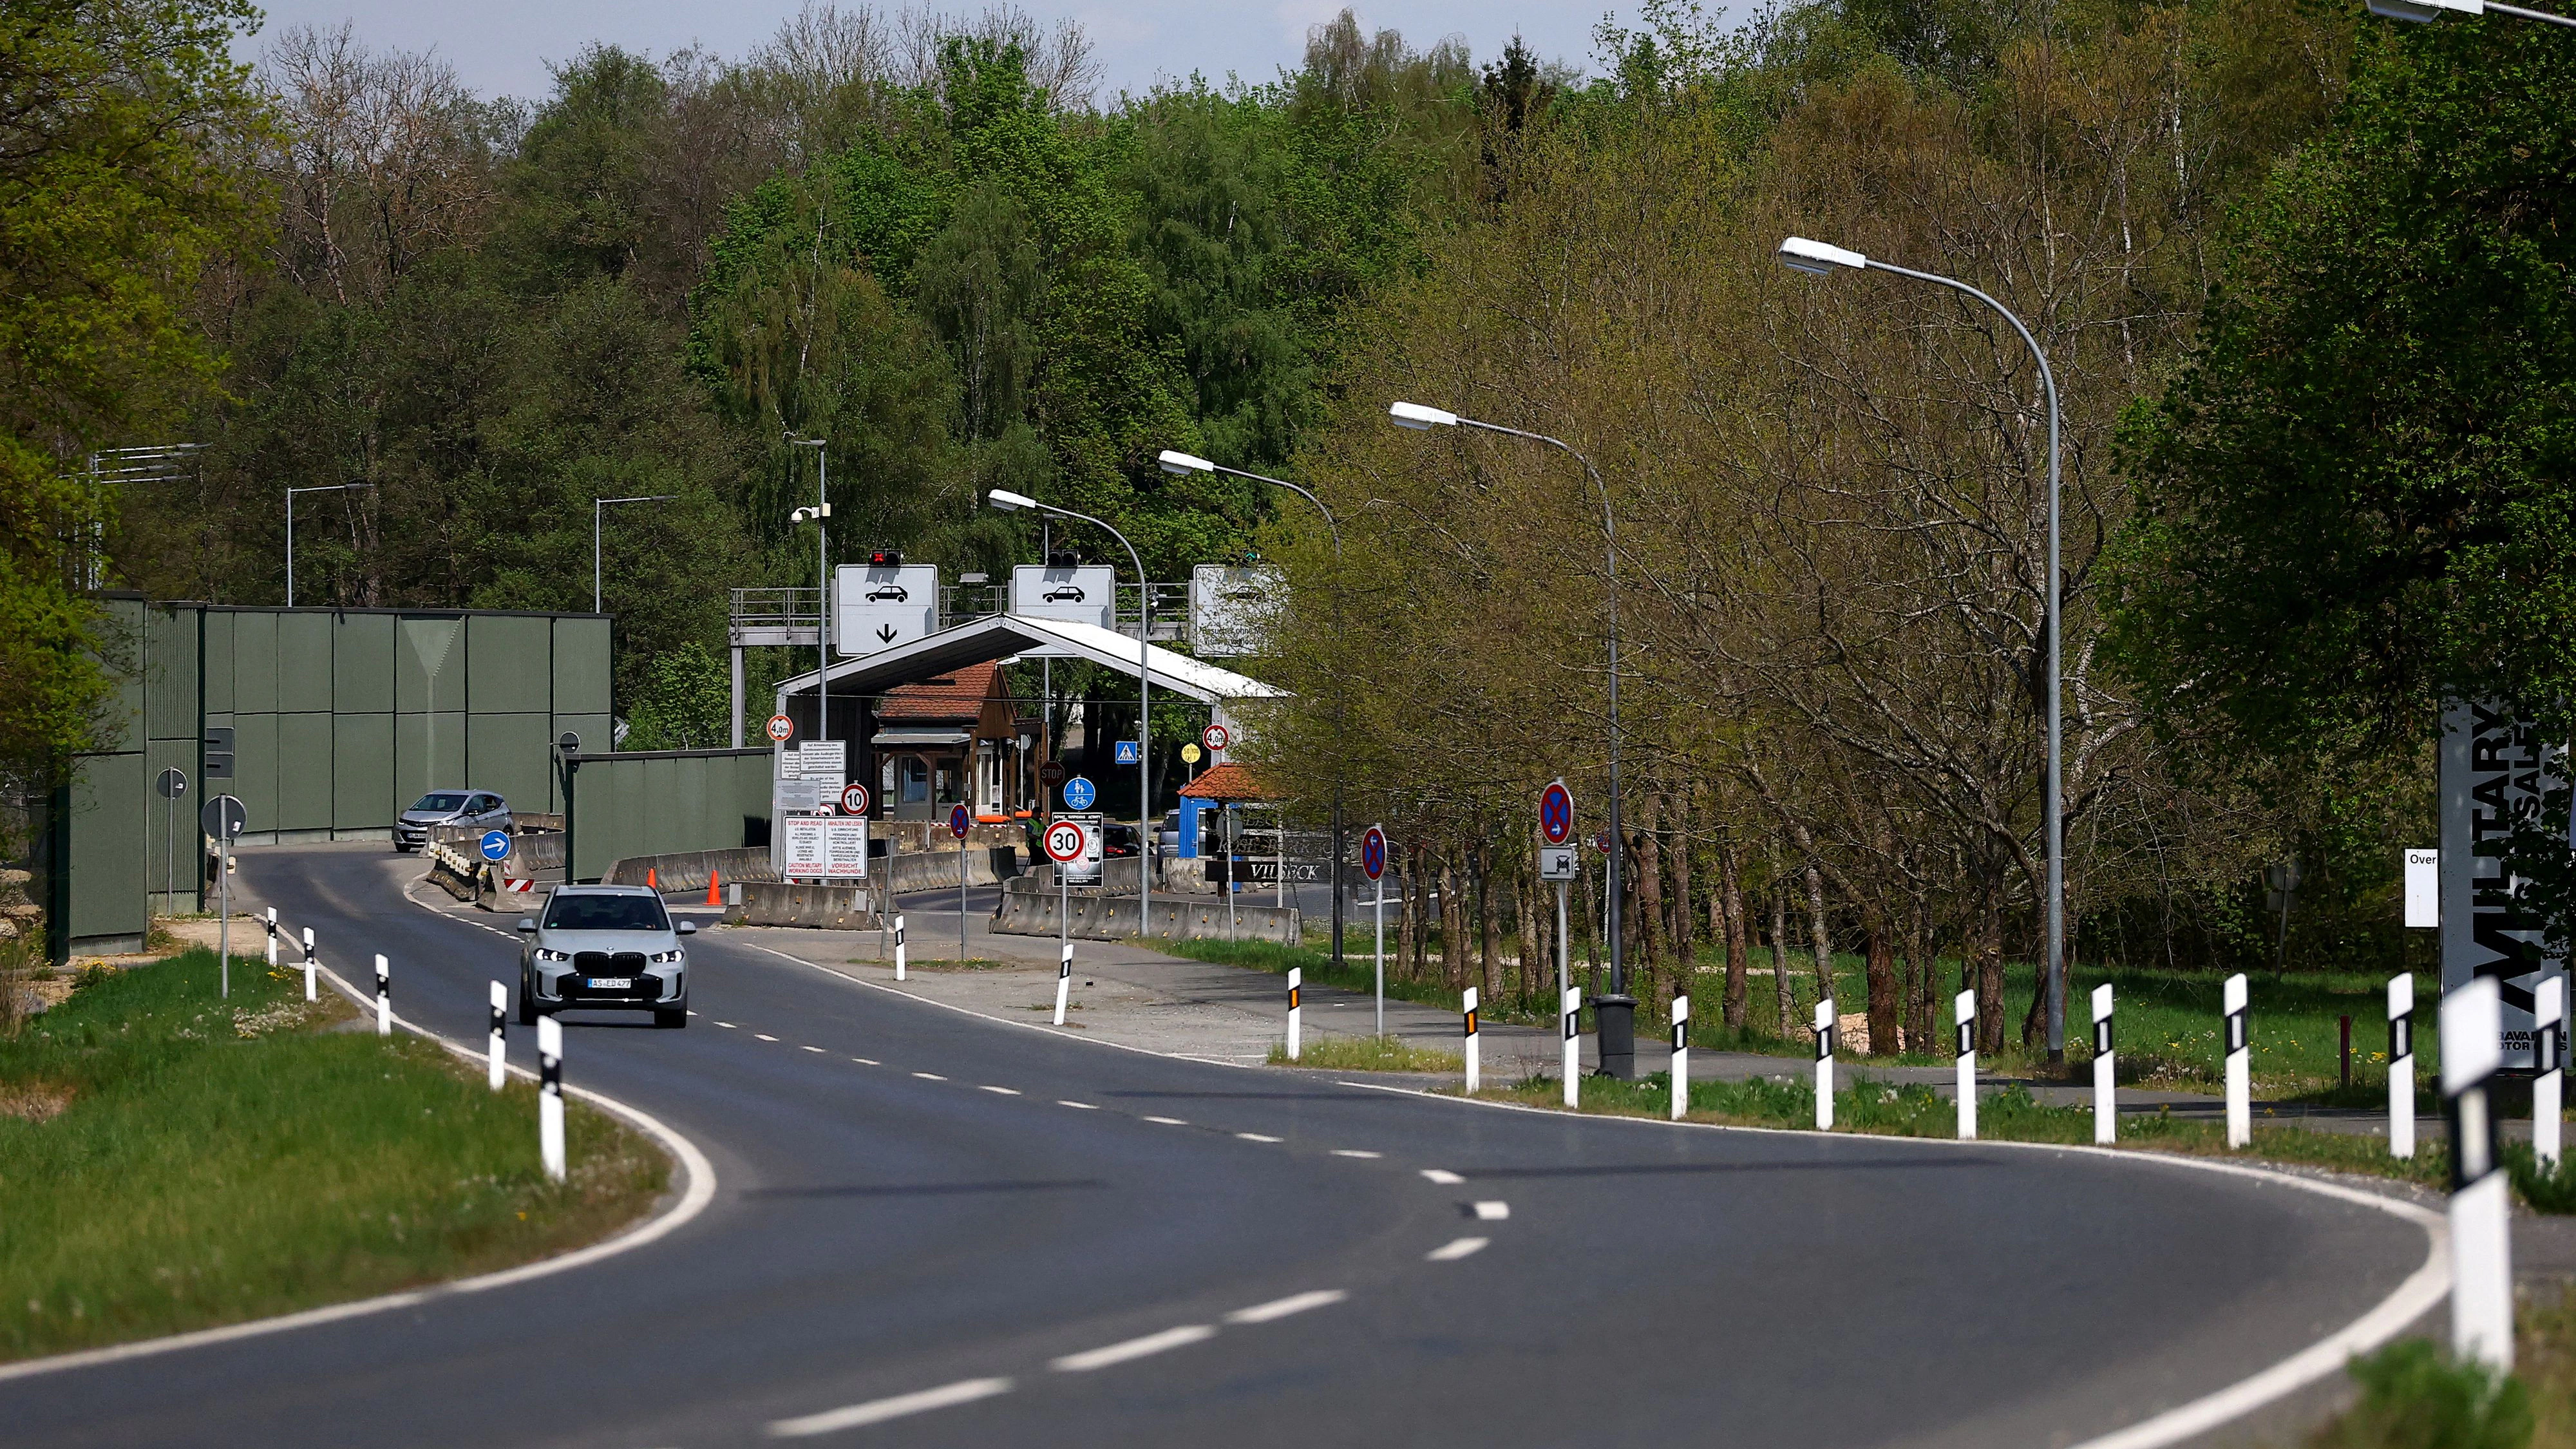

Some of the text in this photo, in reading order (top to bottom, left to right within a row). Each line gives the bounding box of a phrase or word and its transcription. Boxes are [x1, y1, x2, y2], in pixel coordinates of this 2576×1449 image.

[771, 723, 789, 734] 4,0m
[1041, 769, 1062, 779] STOP
[848, 793, 862, 806] 10
[1053, 833, 1075, 850] 30
[2410, 854, 2436, 864] Over
[2498, 1031, 2567, 1041] BAVAN
